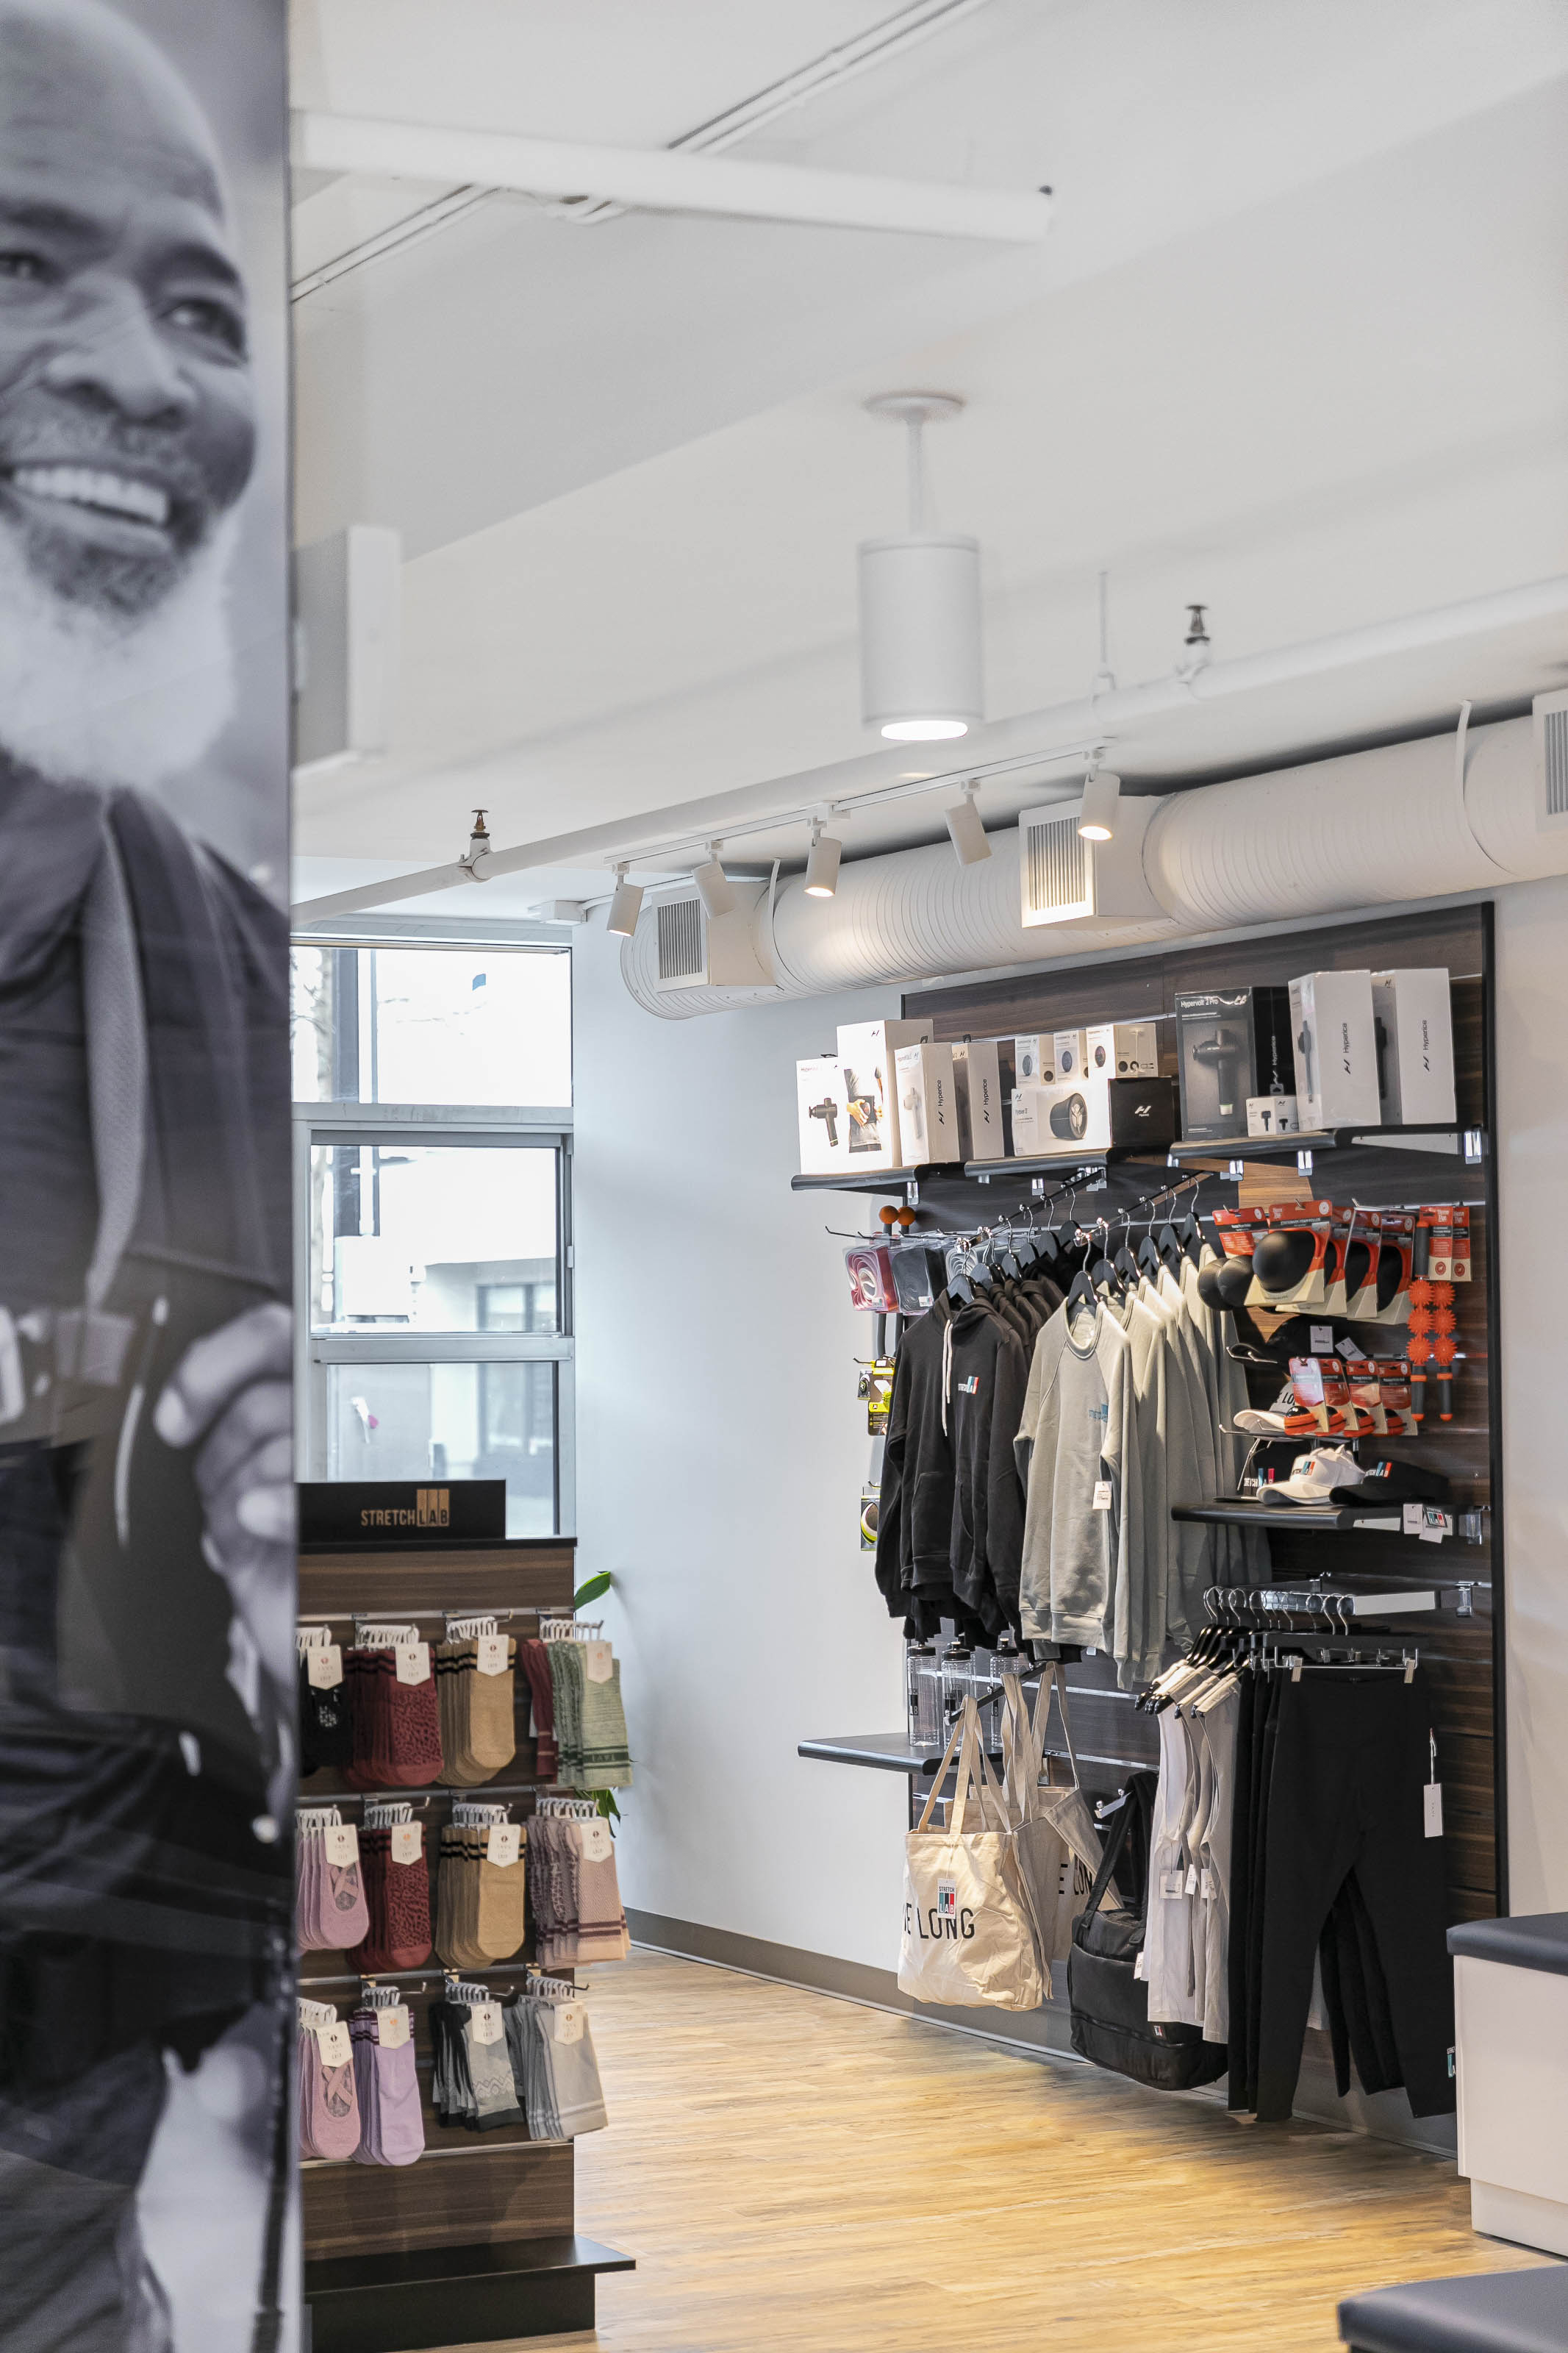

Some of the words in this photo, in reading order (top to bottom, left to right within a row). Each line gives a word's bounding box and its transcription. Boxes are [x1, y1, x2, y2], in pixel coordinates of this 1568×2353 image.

[1181, 999, 1205, 1009] Hypervolt
[1422, 1020, 1431, 1051] Hyperice
[1282, 1392, 1295, 1404] LO
[1073, 1853, 1093, 1895] LON
[917, 1907, 975, 1939] LONG
